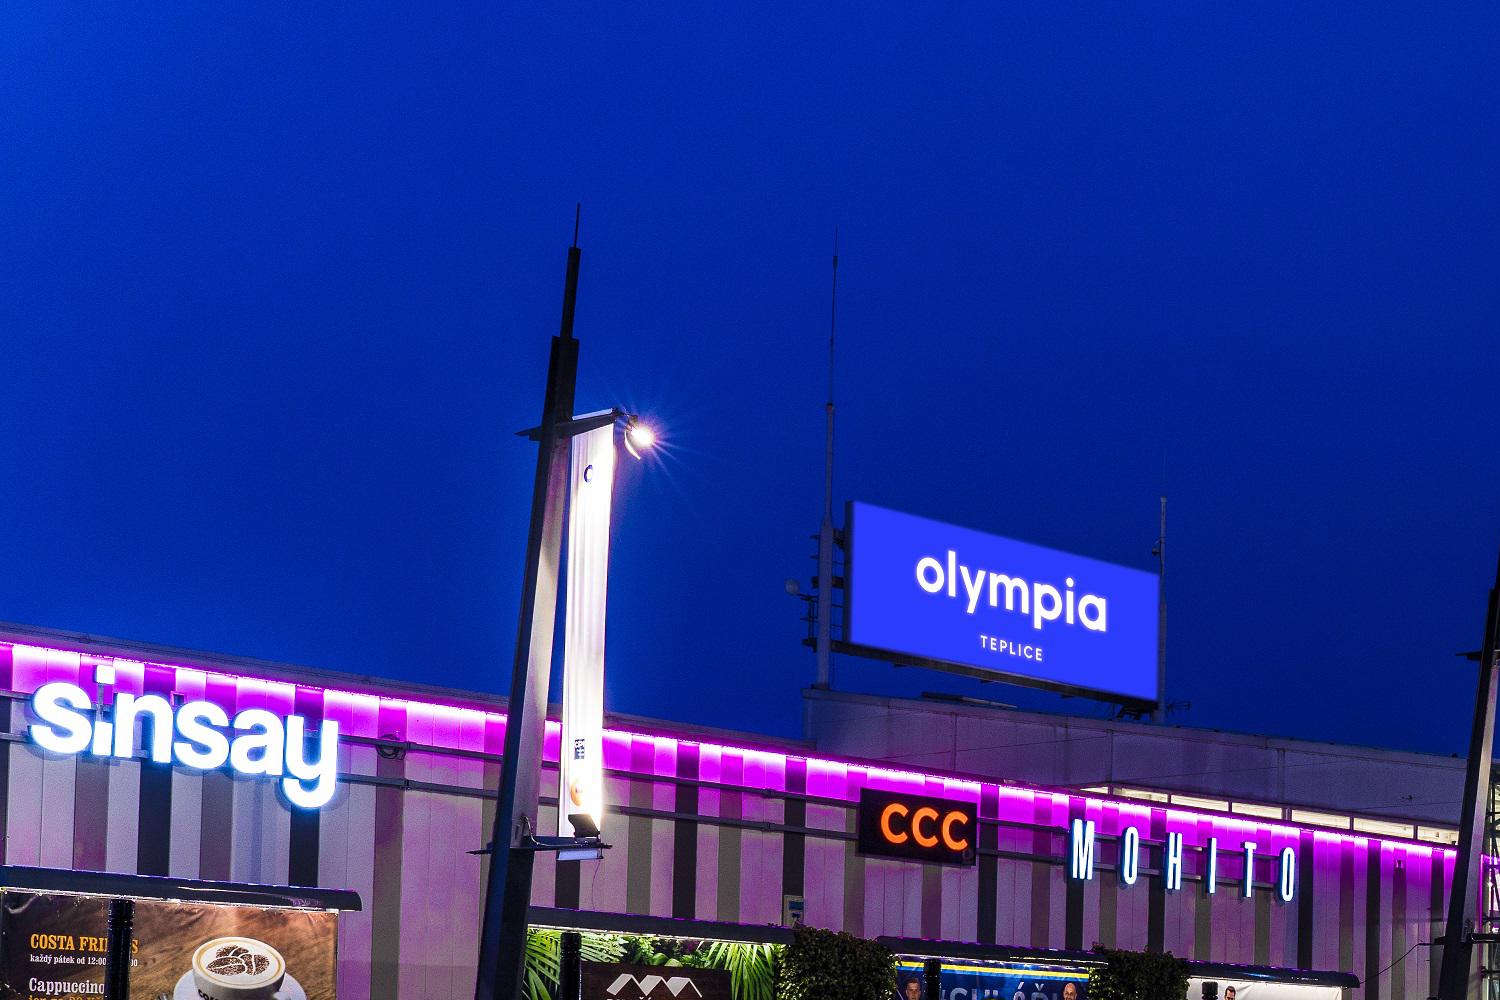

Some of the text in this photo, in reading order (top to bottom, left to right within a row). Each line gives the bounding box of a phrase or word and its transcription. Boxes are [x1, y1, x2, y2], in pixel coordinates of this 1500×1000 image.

[915, 549, 1107, 632] olympia
[979, 635, 1043, 662] TEPLICE
[30, 665, 339, 808] sinsay
[880, 802, 969, 852] CCC
[1070, 818, 1297, 902] MOHITO
[30, 933, 139, 954] COSTA FRIS
[30, 954, 52, 965] každý
[53, 955, 75, 965] pátek
[76, 956, 86, 965] od
[28, 977, 105, 996] Cappuccino
